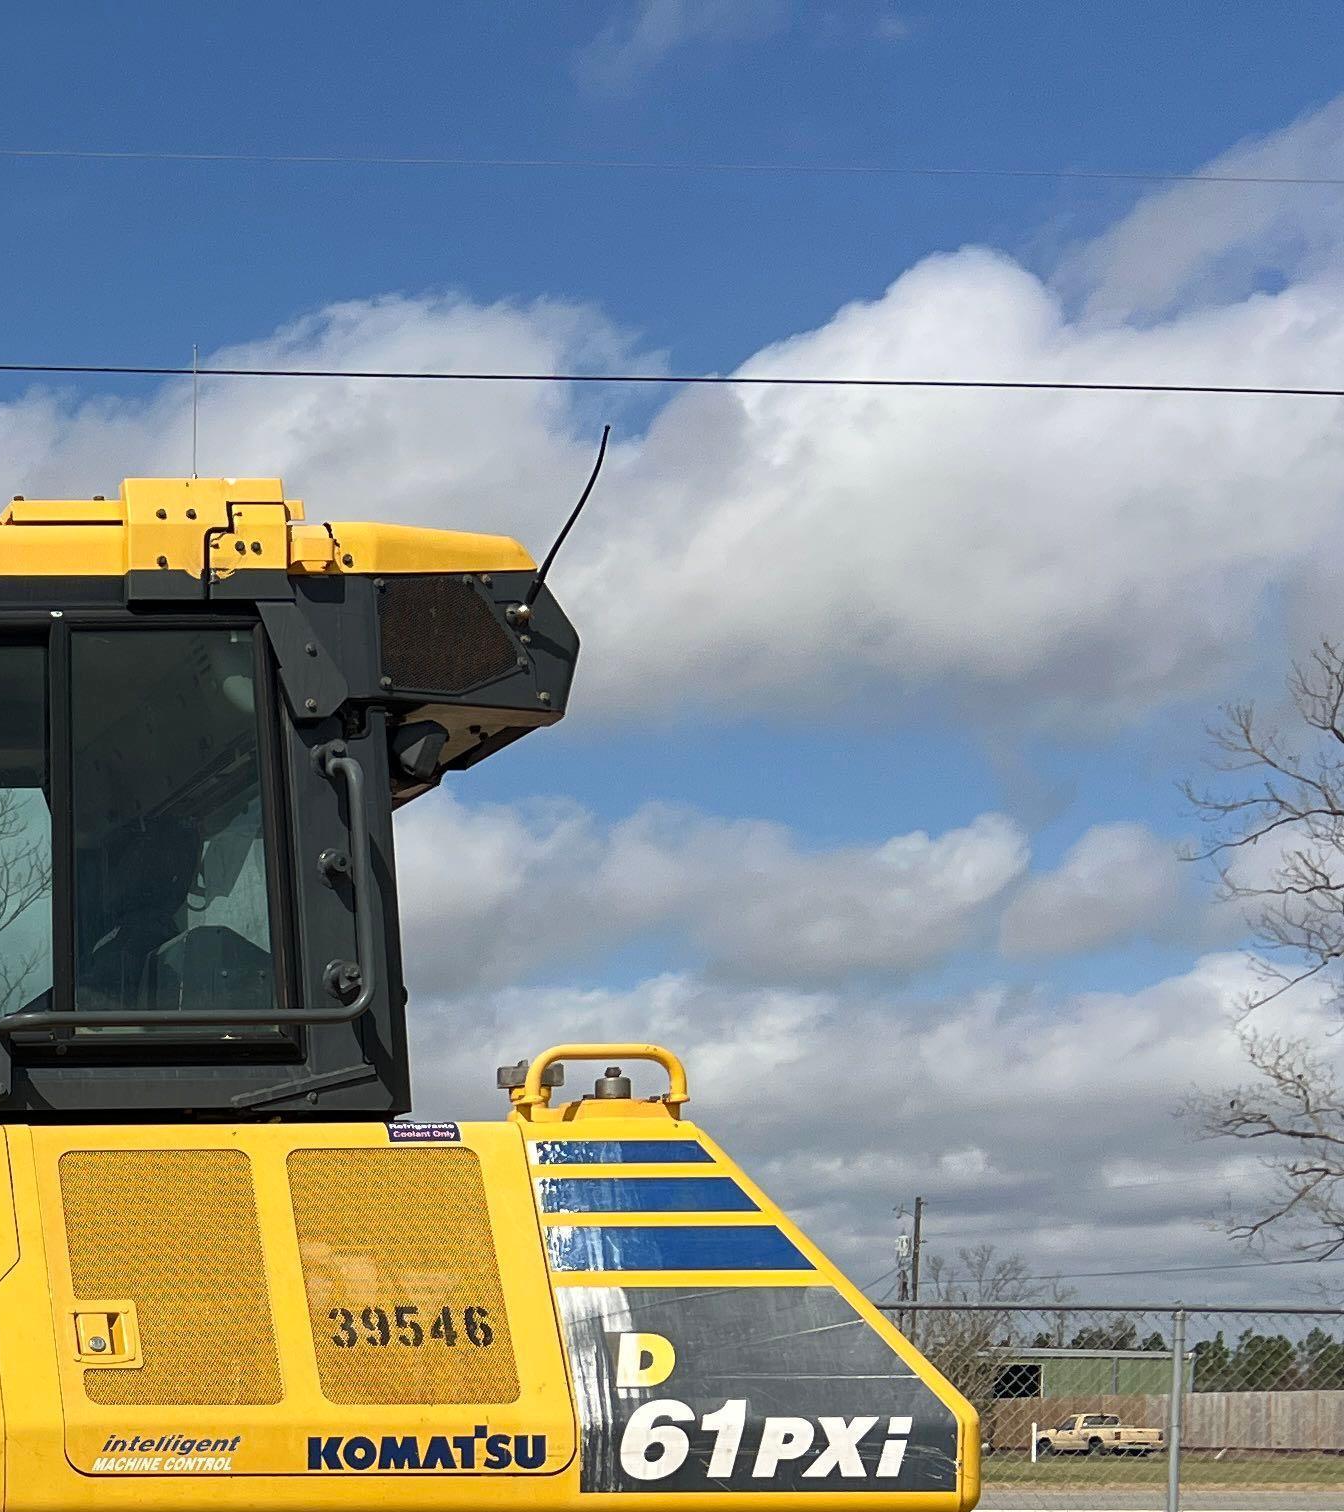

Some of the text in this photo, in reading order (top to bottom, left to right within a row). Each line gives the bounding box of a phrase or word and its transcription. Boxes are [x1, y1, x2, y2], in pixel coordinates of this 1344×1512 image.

[393, 1130, 455, 1139] Coolant Only
[328, 1305, 494, 1348] 39546
[616, 1332, 676, 1388] D
[102, 1435, 241, 1456] intelligent
[307, 1425, 547, 1470] KOMATSU
[620, 1399, 913, 1481] 61PXi
[92, 1457, 232, 1472] MACHINE CONTROL
